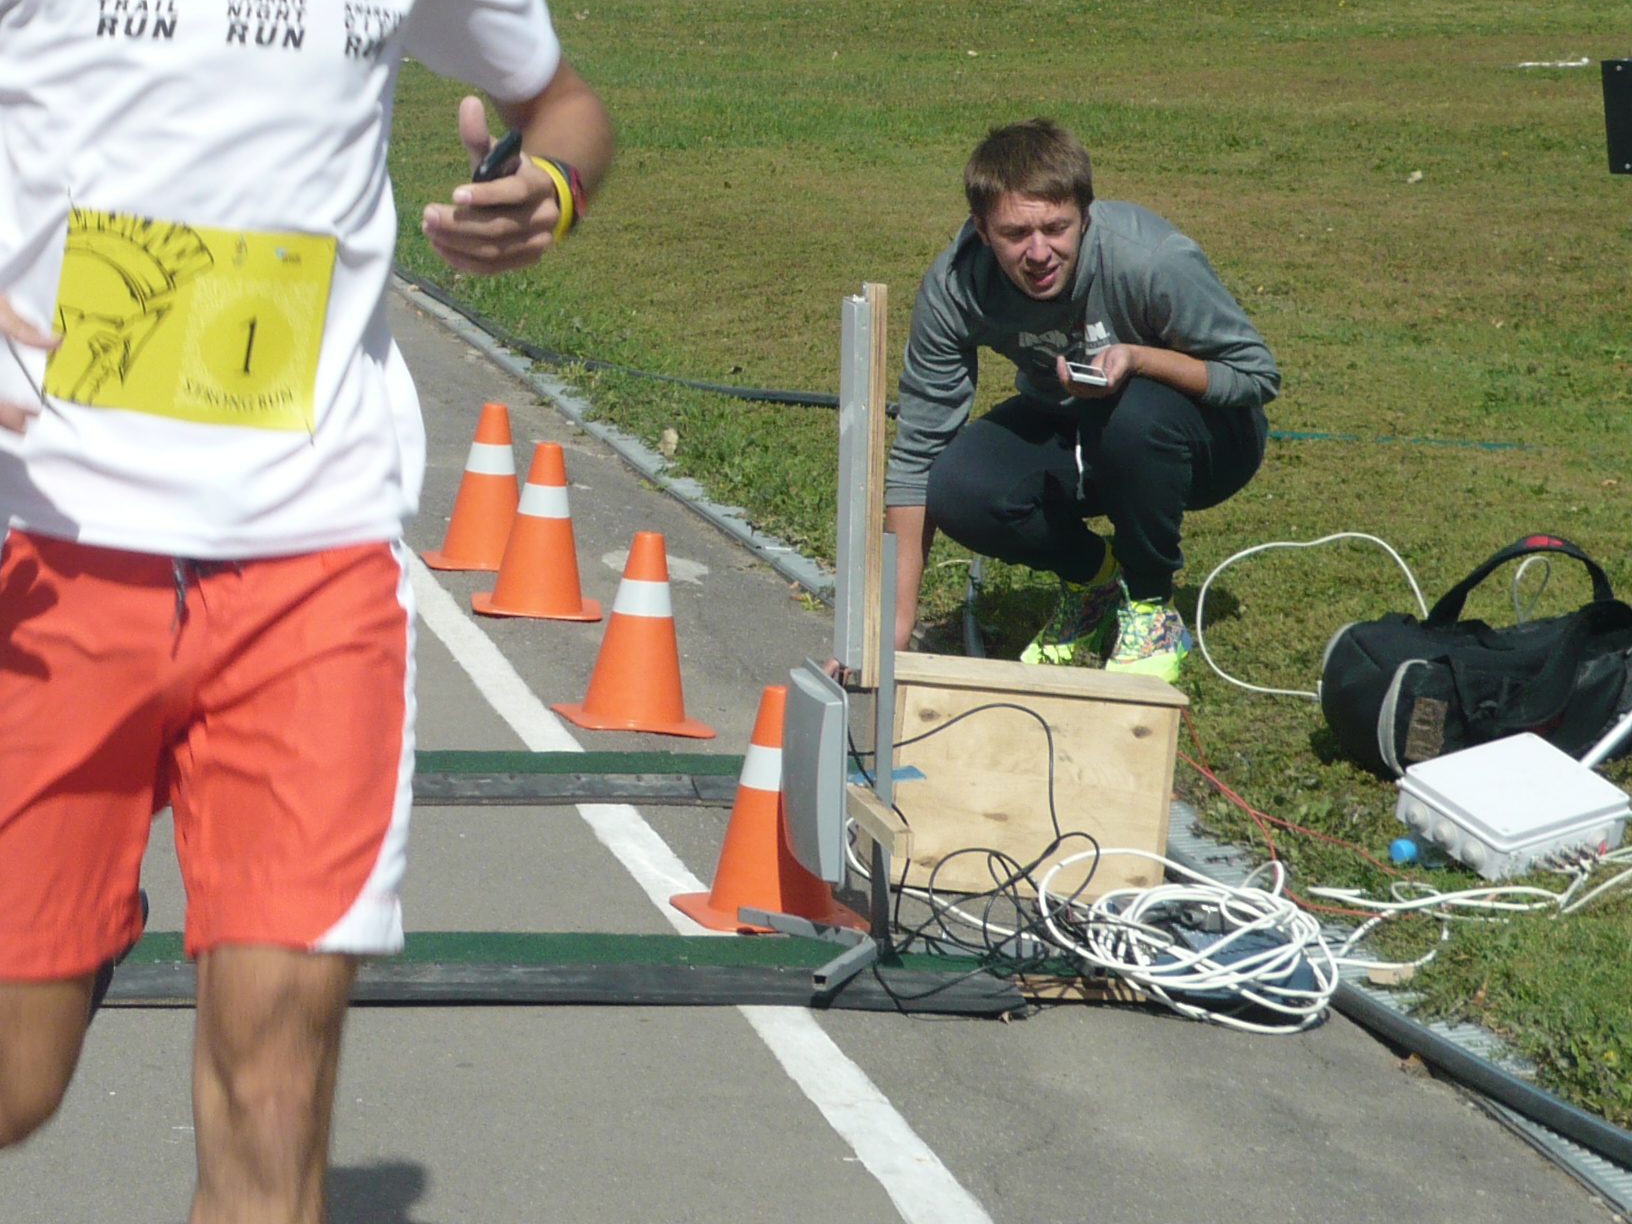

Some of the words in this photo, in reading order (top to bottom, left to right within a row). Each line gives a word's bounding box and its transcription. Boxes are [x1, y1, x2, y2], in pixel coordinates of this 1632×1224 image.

[95, 15, 179, 39] RUN
[225, 22, 306, 49] RUN
[243, 315, 258, 376] 1
